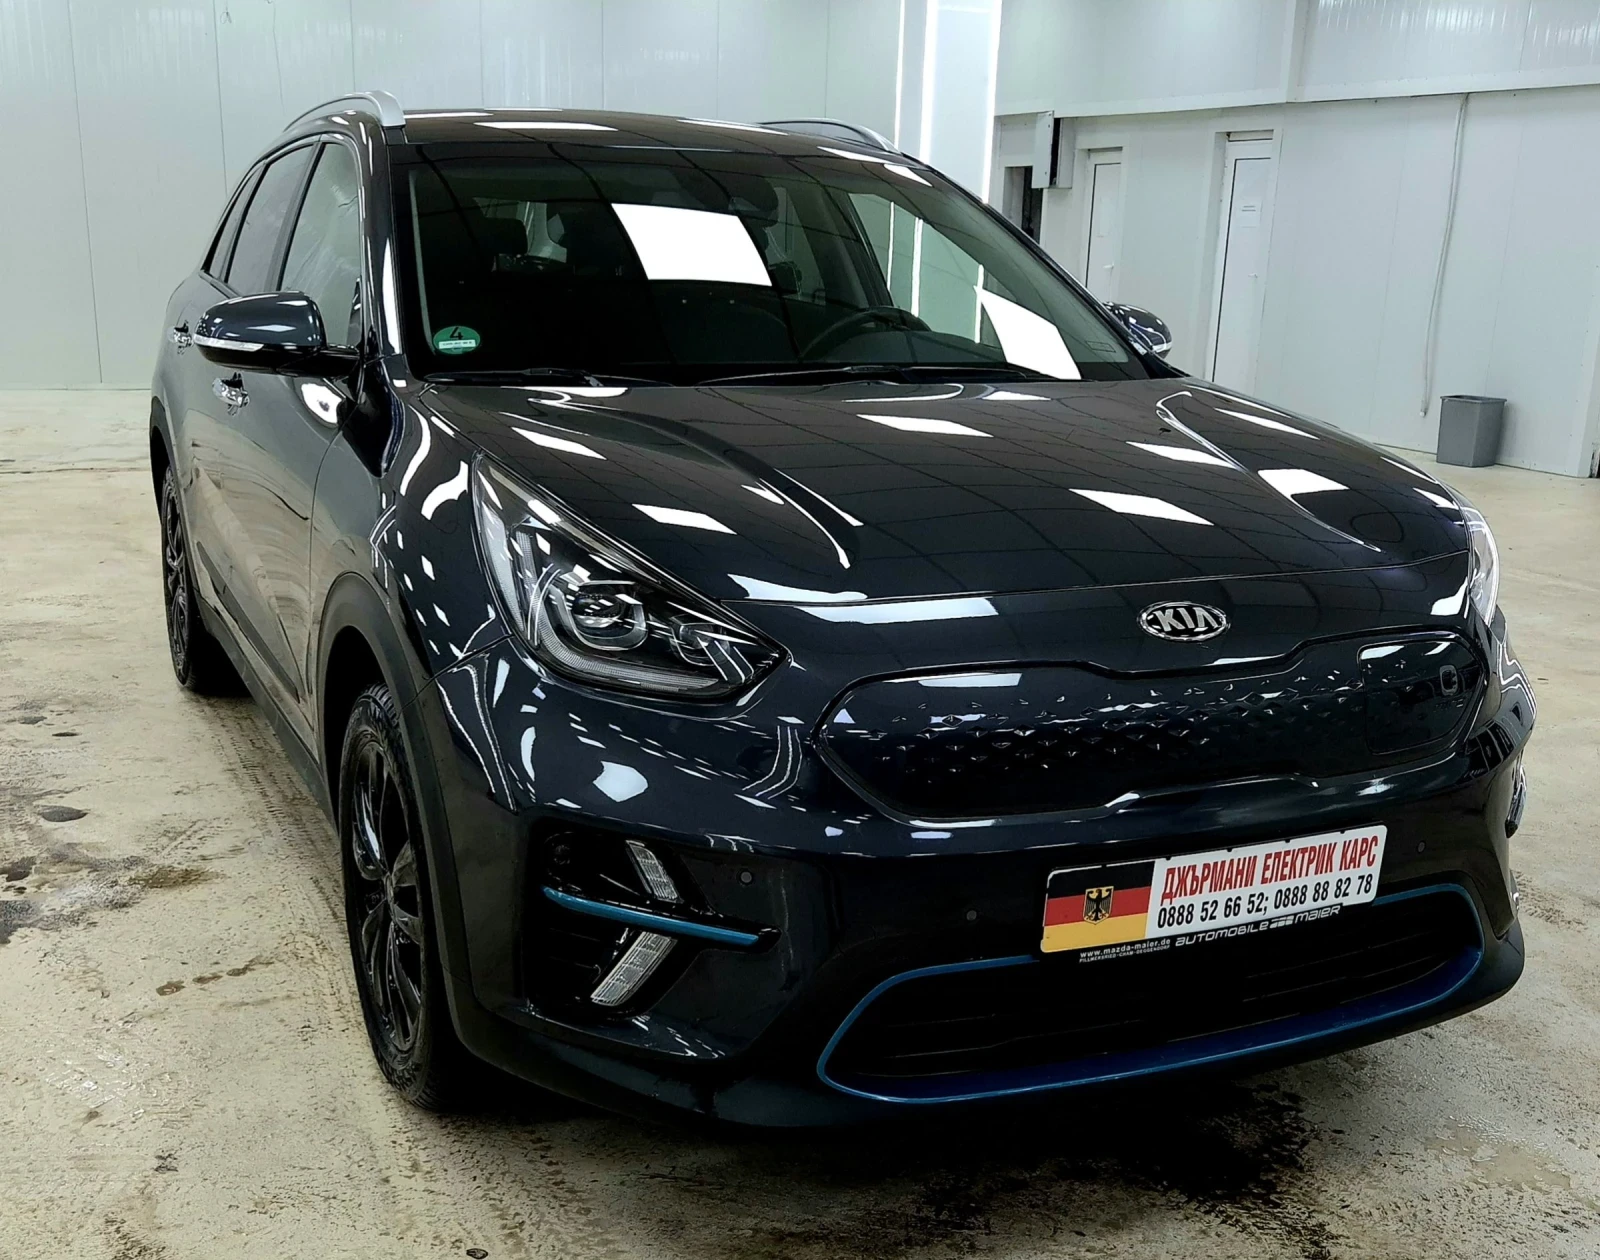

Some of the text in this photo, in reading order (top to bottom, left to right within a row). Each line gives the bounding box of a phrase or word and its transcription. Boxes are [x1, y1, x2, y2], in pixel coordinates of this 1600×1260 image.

[449, 326, 464, 340] 4
[1153, 607, 1219, 632] KIA
[1160, 835, 1379, 906] ДЖЪРМАНИ ЕЛЕКТРИК КАРС
[1157, 873, 1373, 928] 0888 52 66 52; 0888 88 82 78
[1080, 938, 1171, 958] www.mazda-maier.de
